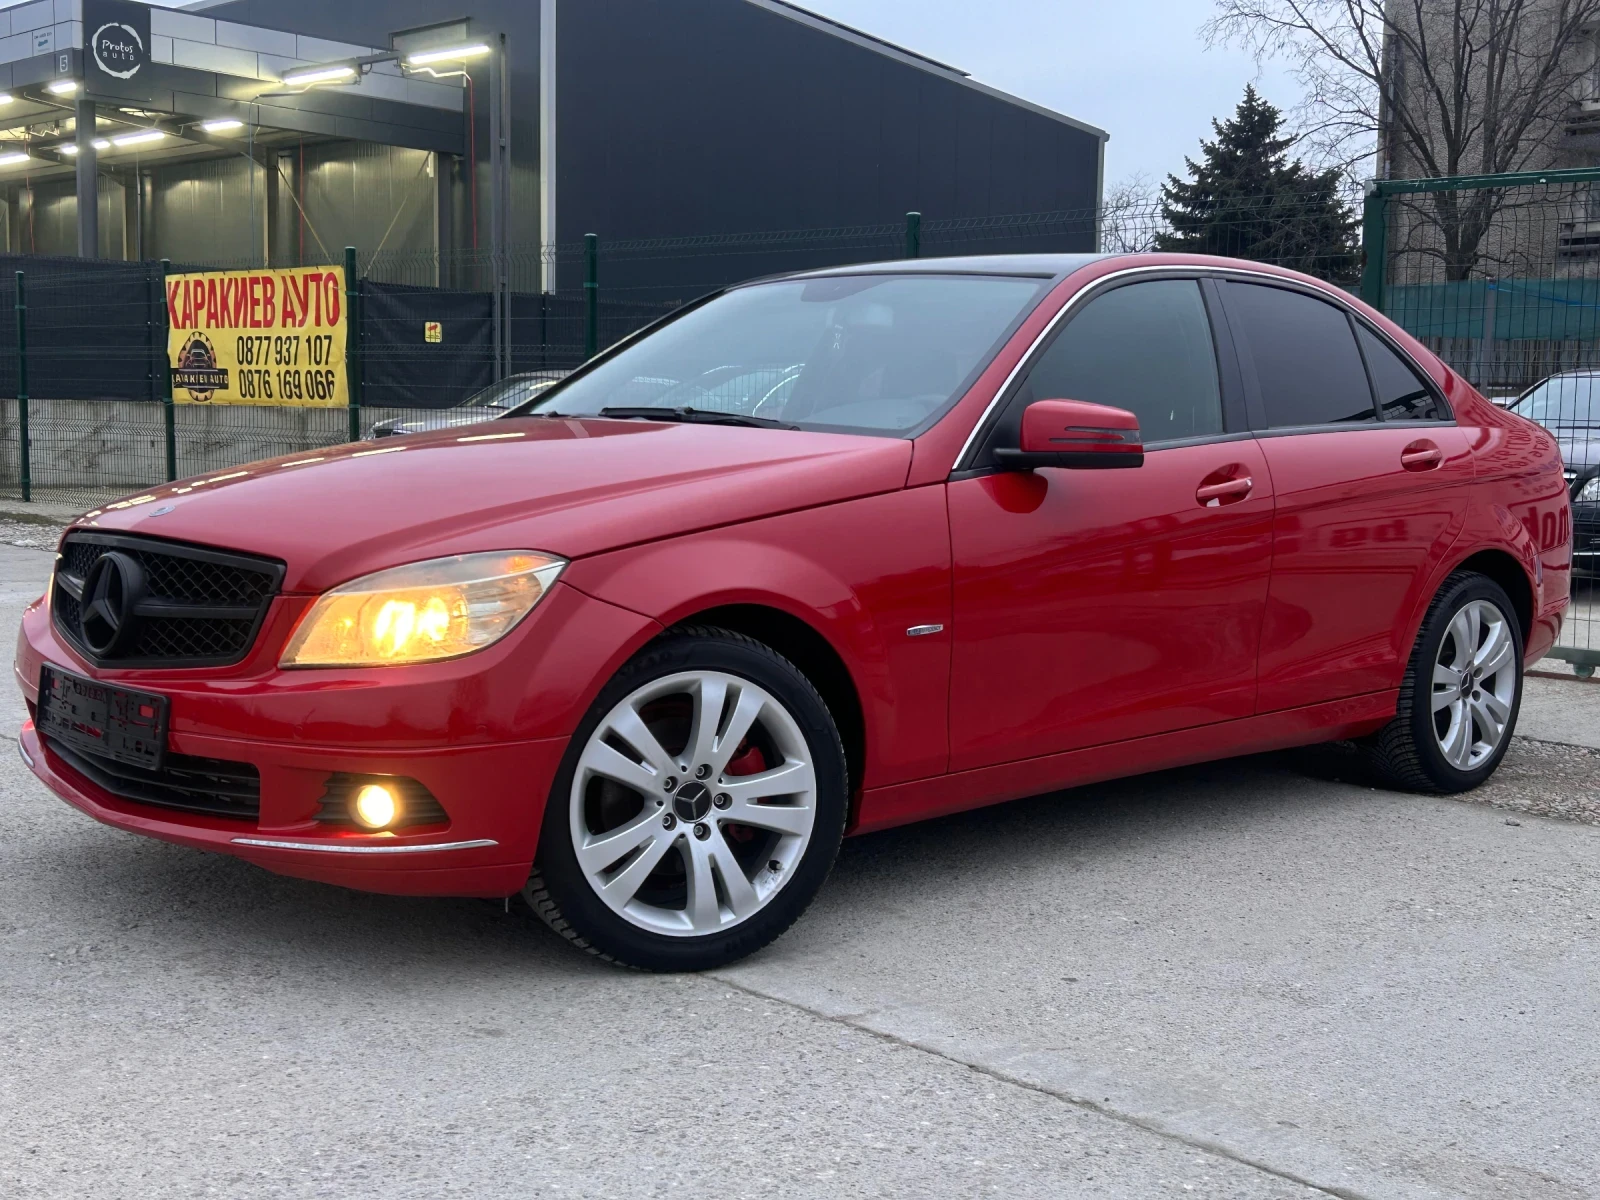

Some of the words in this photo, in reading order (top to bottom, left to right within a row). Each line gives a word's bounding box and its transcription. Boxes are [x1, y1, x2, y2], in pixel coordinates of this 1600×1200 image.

[102, 40, 133, 53] Protos
[167, 276, 275, 329] КАРАКИЕВ
[281, 272, 340, 328] АУТО
[236, 336, 271, 365] 0877
[274, 335, 300, 365] 937
[306, 335, 332, 365] 107
[238, 369, 273, 398] 0876
[276, 369, 303, 399] 169
[305, 370, 335, 400] 066
